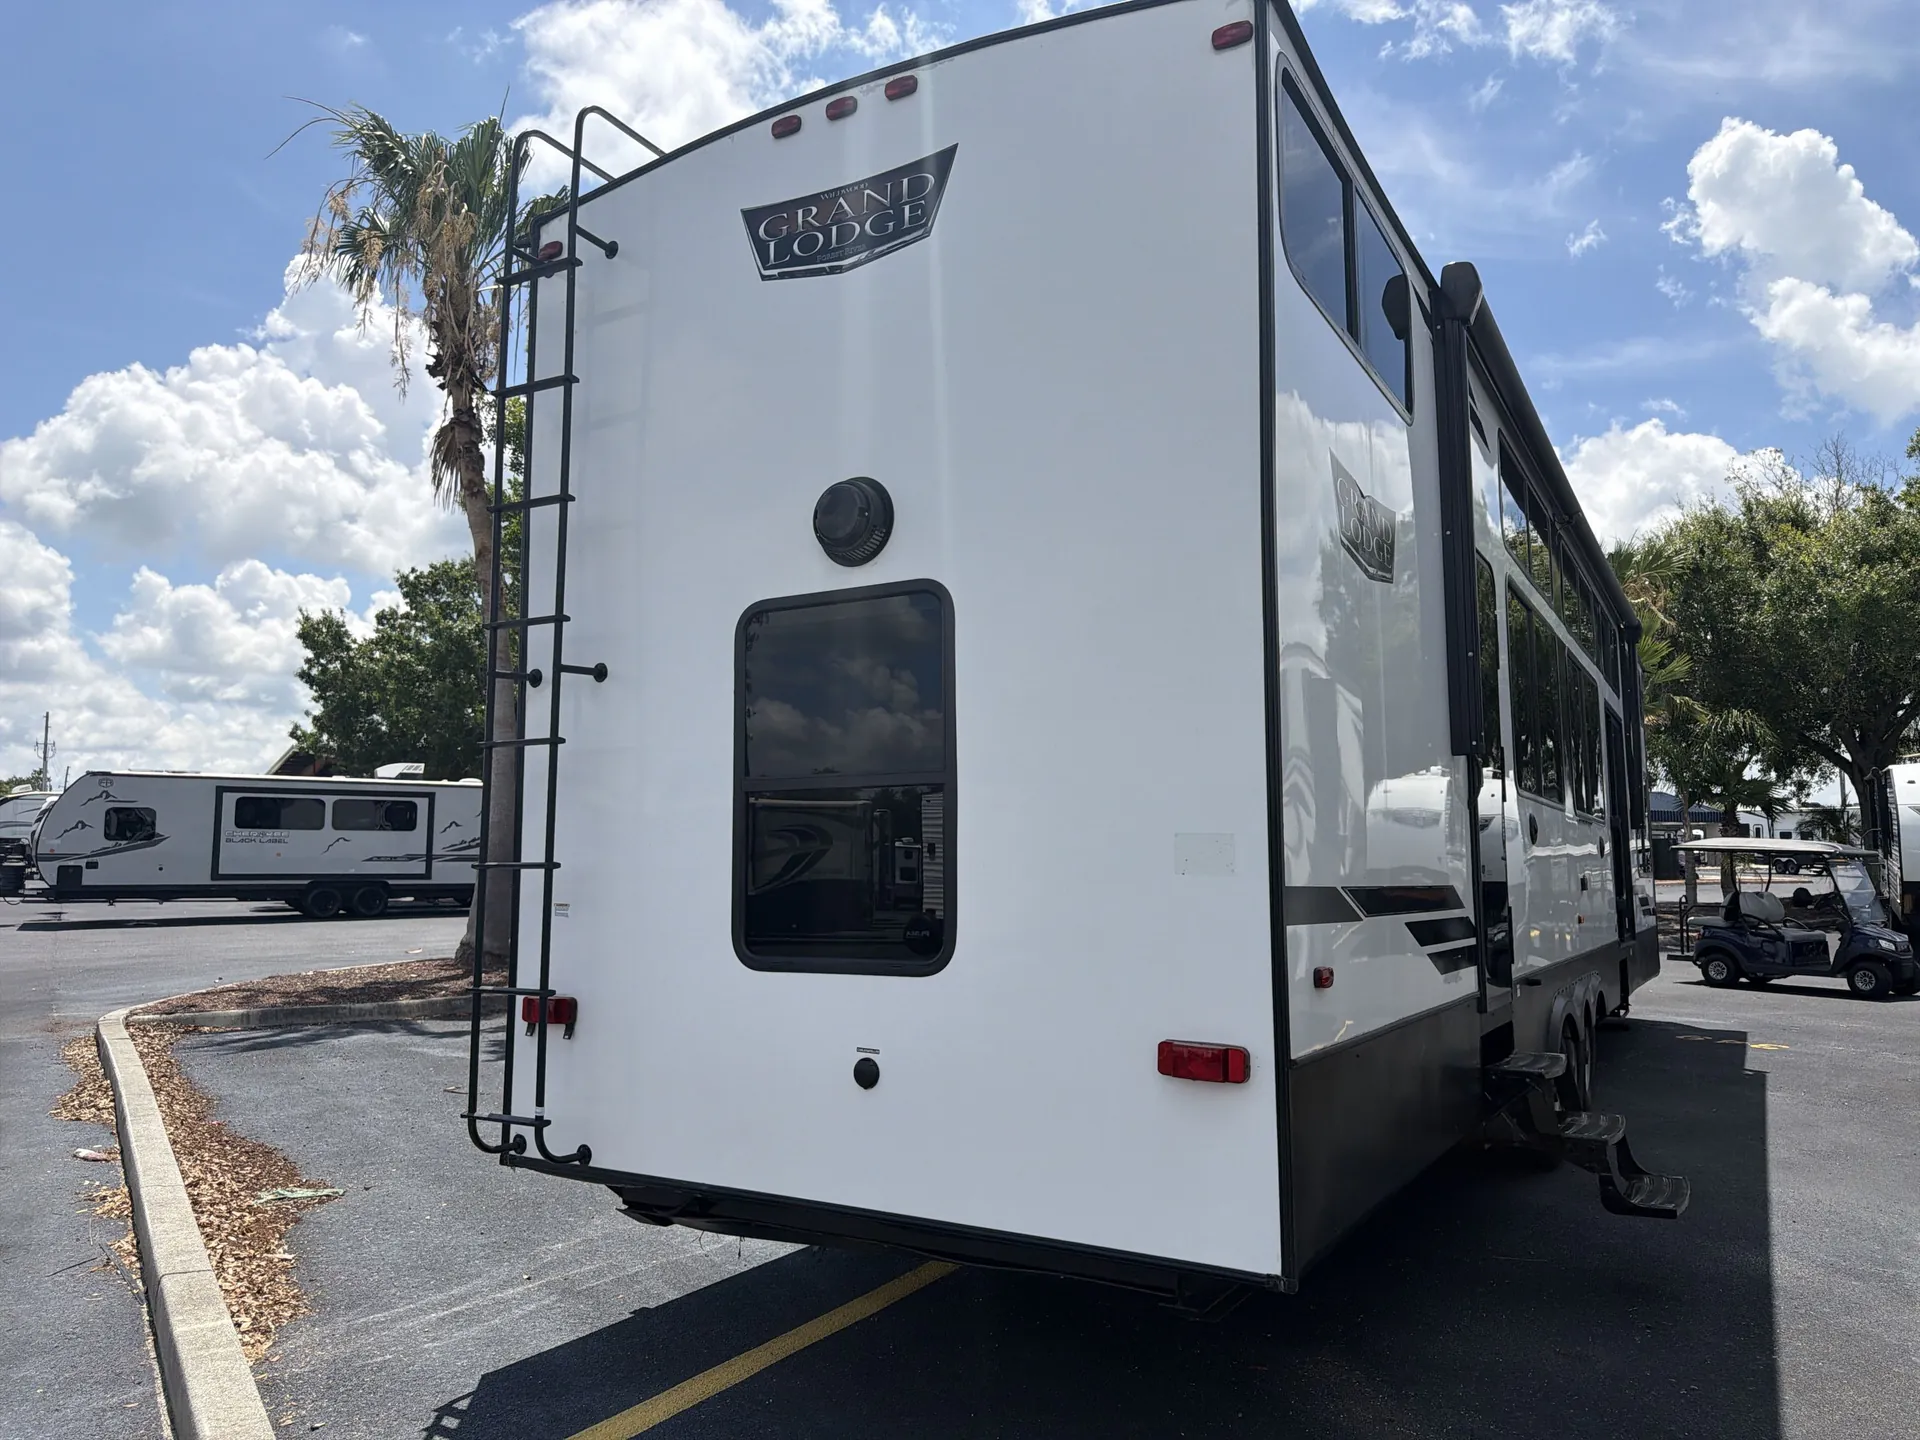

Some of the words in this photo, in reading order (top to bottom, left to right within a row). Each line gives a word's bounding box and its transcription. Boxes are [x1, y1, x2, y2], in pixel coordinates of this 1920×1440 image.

[758, 173, 935, 241] GRAND
[765, 200, 927, 267] LODGE
[1337, 477, 1393, 544] GRAND
[1340, 505, 1392, 569] LODGE
